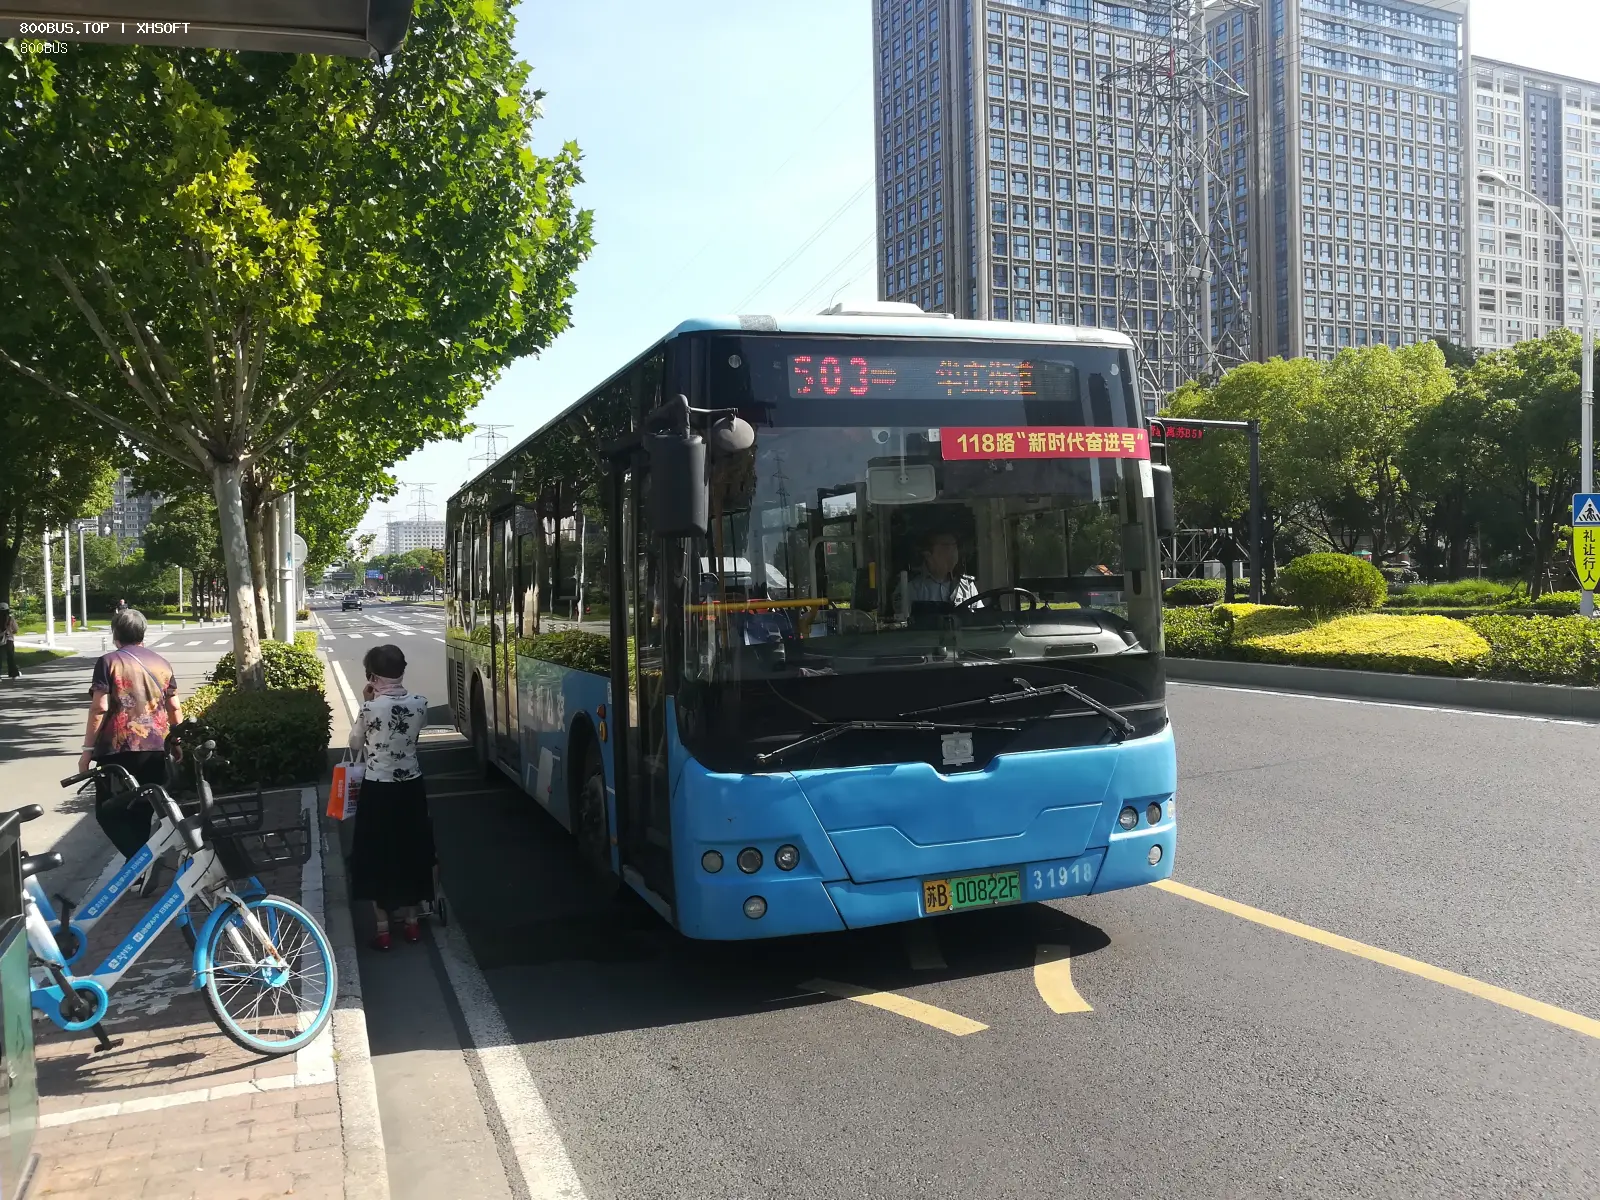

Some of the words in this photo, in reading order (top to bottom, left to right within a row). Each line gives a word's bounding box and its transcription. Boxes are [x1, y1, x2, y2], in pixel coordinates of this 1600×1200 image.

[794, 355, 868, 395] 503
[1582, 529, 1597, 583] 礼让行人
[1033, 862, 1093, 891] 31918
